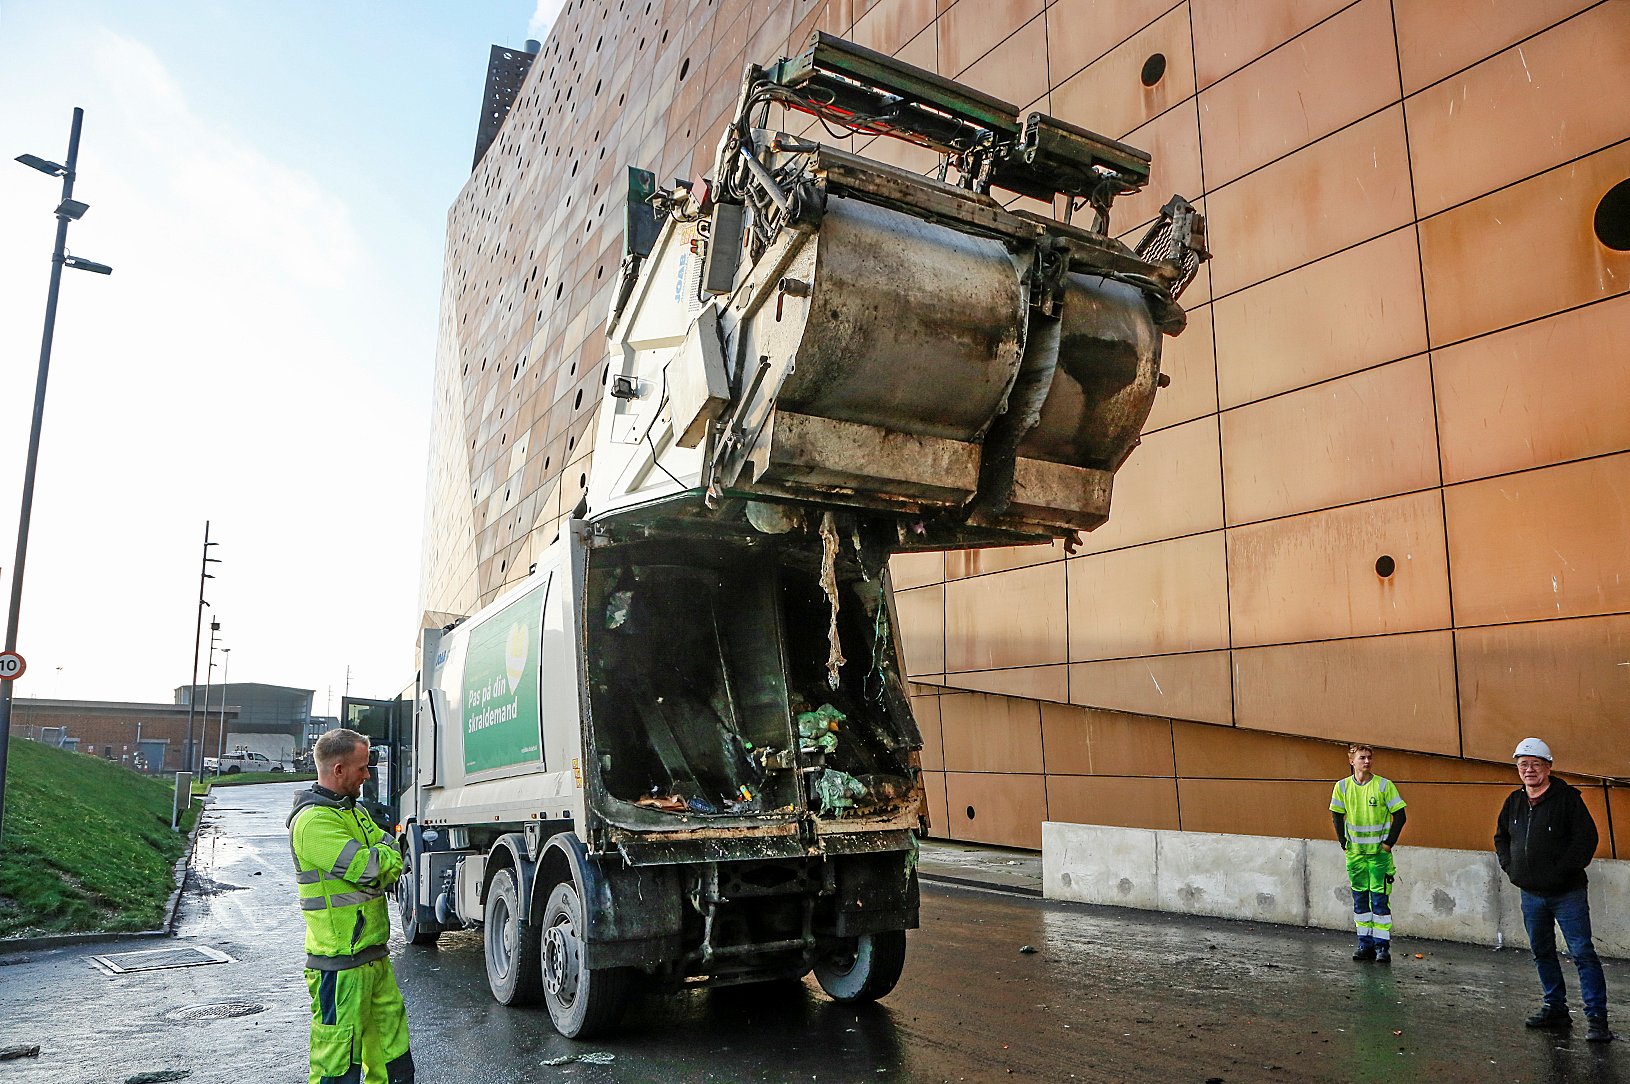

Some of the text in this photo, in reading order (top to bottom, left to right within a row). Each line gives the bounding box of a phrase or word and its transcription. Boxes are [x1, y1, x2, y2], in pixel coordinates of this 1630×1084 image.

[675, 254, 687, 304] JOAB
[0, 660, 17, 671] 10
[468, 674, 506, 709] Pas på din
[468, 695, 518, 734] skraldemand
